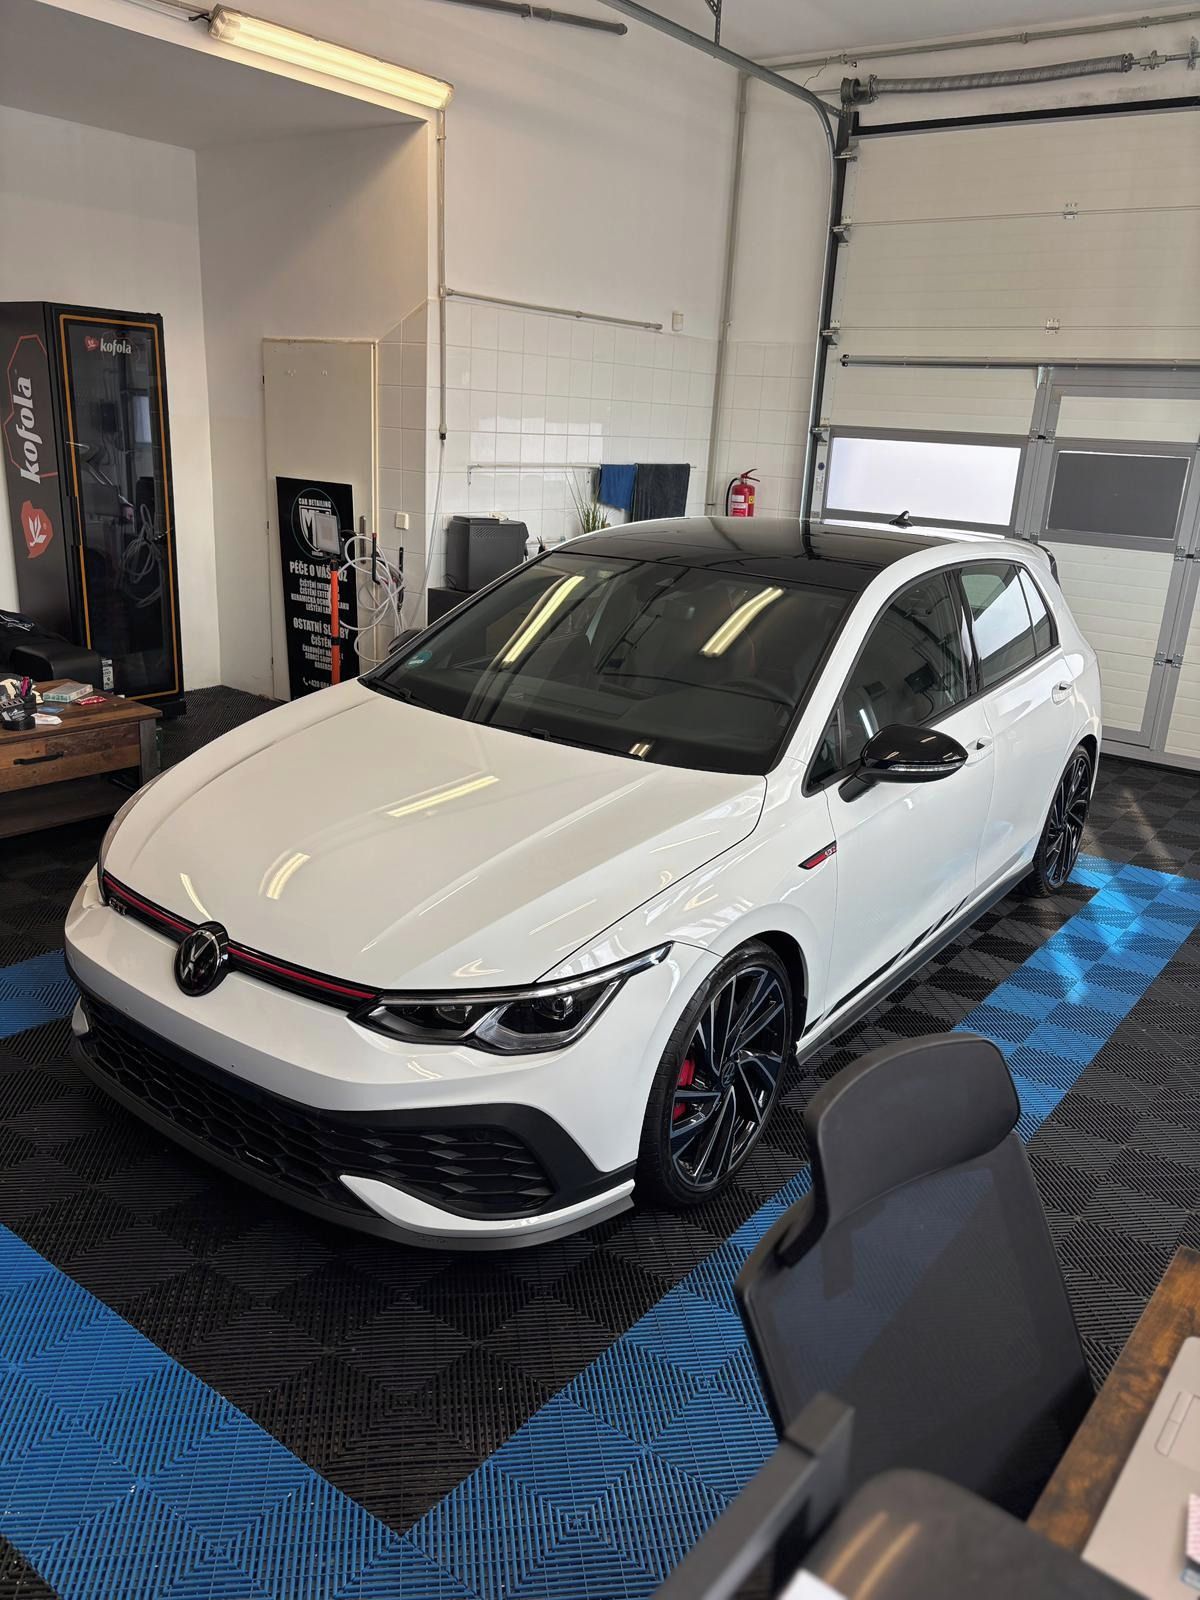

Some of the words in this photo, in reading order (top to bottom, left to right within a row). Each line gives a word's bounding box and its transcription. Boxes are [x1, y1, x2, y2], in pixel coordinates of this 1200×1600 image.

[100, 338, 132, 356] kofola
[13, 377, 43, 485] kofola
[289, 560, 309, 575] PÉČE
[310, 564, 316, 577] O
[293, 617, 323, 634] OSTATNÍ
